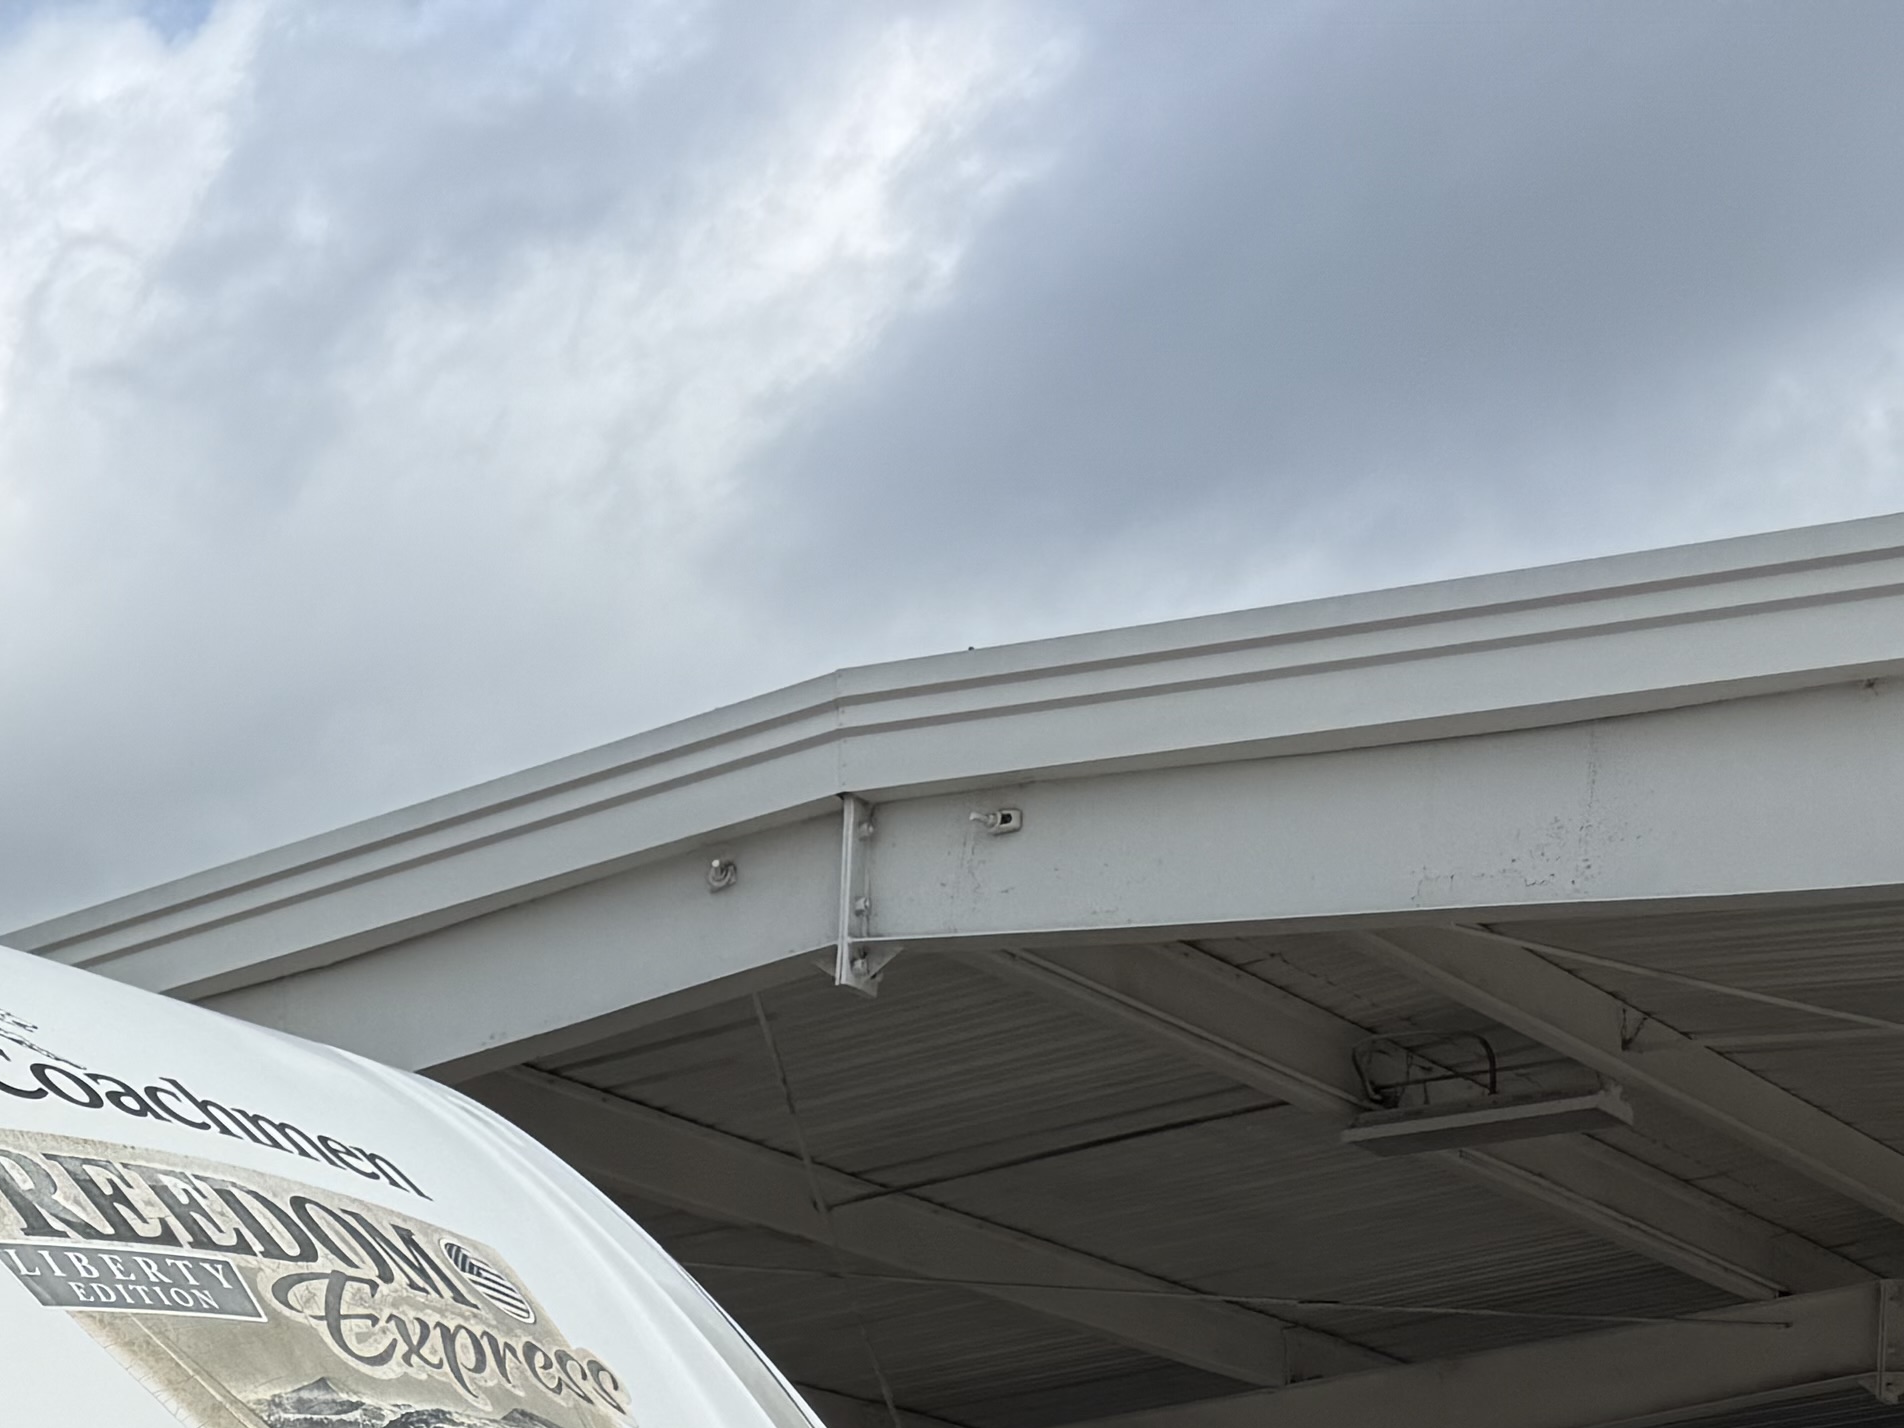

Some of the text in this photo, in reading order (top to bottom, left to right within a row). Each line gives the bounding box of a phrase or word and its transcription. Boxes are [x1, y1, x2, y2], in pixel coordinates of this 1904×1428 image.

[4, 1248, 234, 1290] LIBERTY
[67, 1281, 221, 1310] EDITION
[271, 1269, 626, 1415] Express
